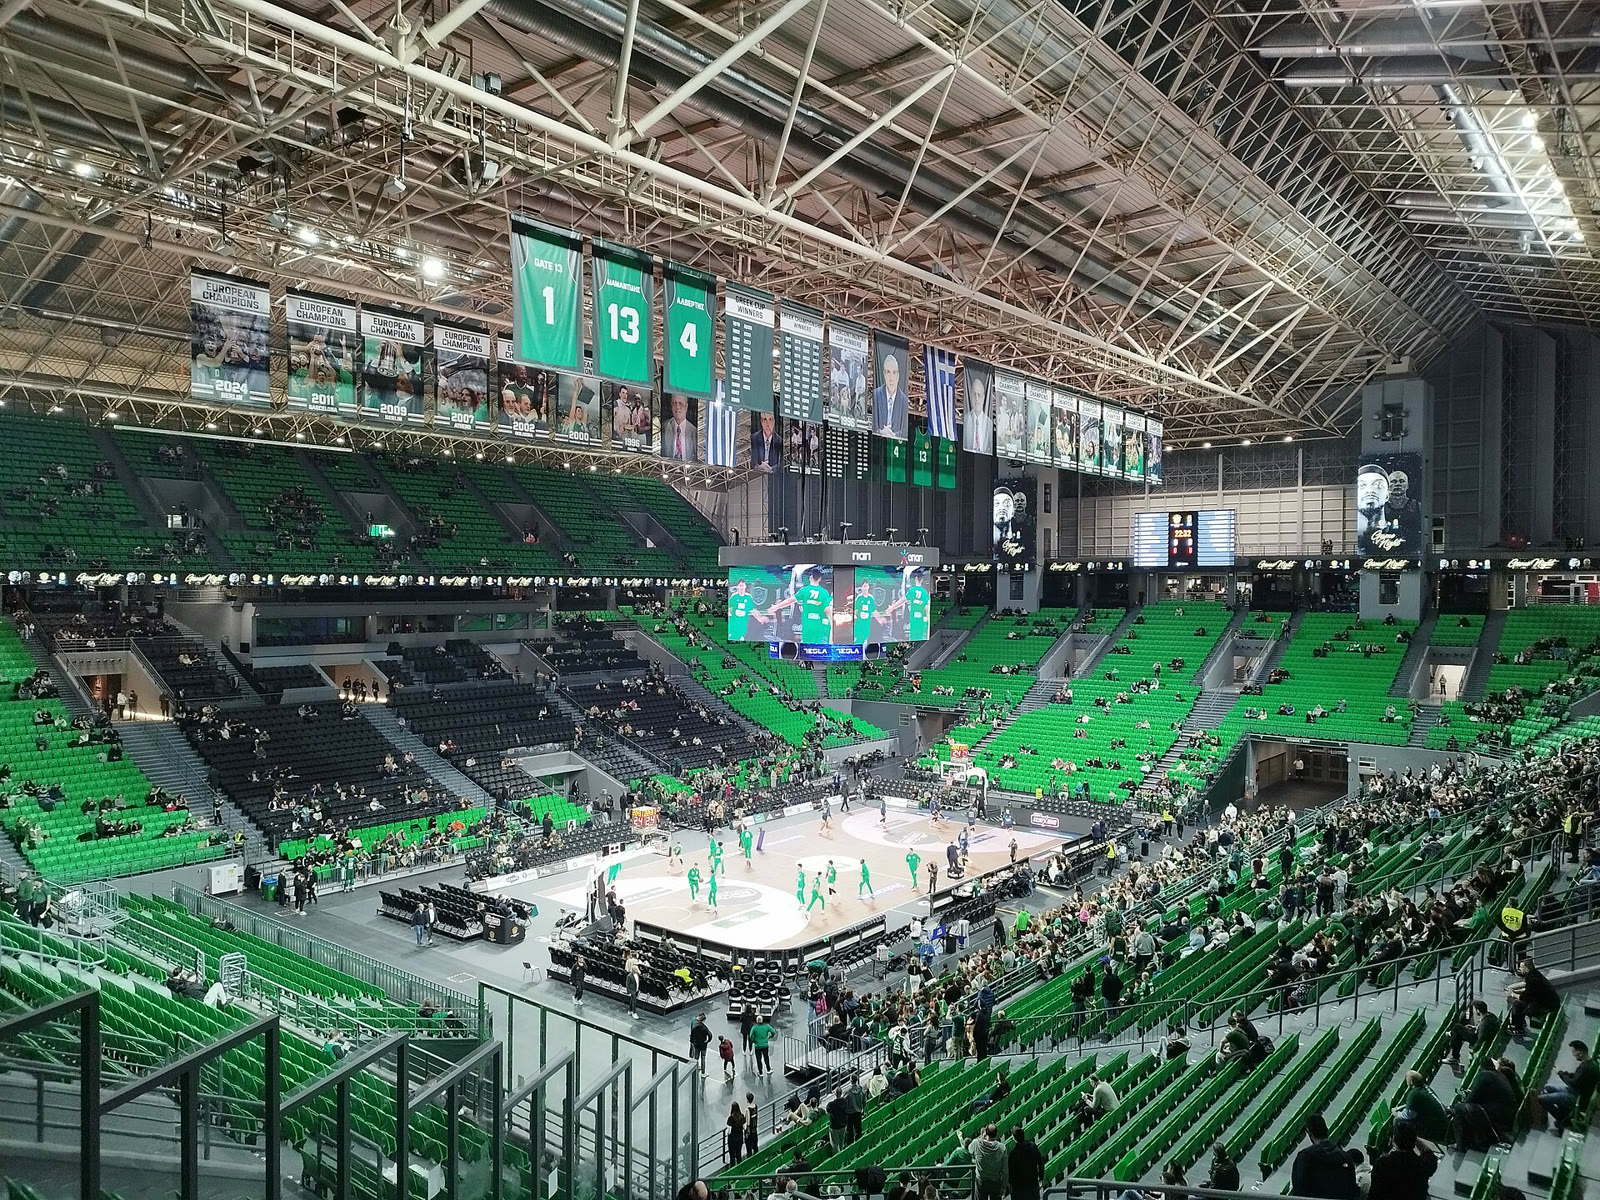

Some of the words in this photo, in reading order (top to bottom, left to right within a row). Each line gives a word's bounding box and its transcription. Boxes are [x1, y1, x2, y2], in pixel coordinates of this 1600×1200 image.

[534, 258, 552, 271] GATE
[554, 263, 563, 272] 13
[206, 282, 256, 300] EUROPEAN
[202, 291, 259, 309] CHAMPIONS
[542, 286, 554, 325] 1
[735, 296, 753, 306] GREEK
[754, 300, 766, 309] CUP
[299, 302, 343, 316] EUROPEAN
[737, 306, 763, 319] WINNERS
[296, 310, 346, 326] CHAMPIONS
[608, 302, 640, 344] 13
[373, 318, 413, 332] EUROPEAN
[370, 325, 416, 341] CHAMPIONS
[445, 331, 480, 344] EUROPEAN
[680, 322, 698, 357] 4
[442, 340, 483, 352] CHAMPIONS
[215, 380, 248, 394] 2024
[311, 393, 334, 405] 2011
[380, 404, 407, 416] 2009
[451, 412, 474, 424] 2007
[513, 421, 535, 433] 2002
[569, 430, 590, 441] 2000
[624, 437, 640, 447] 1996
[894, 446, 899, 458] 4
[919, 450, 927, 462] 13
[946, 454, 949, 465] 1
[1371, 530, 1396, 541] Game
[1373, 537, 1406, 551] Night
[1507, 558, 1531, 569] Game
[1530, 558, 1560, 569] Night
